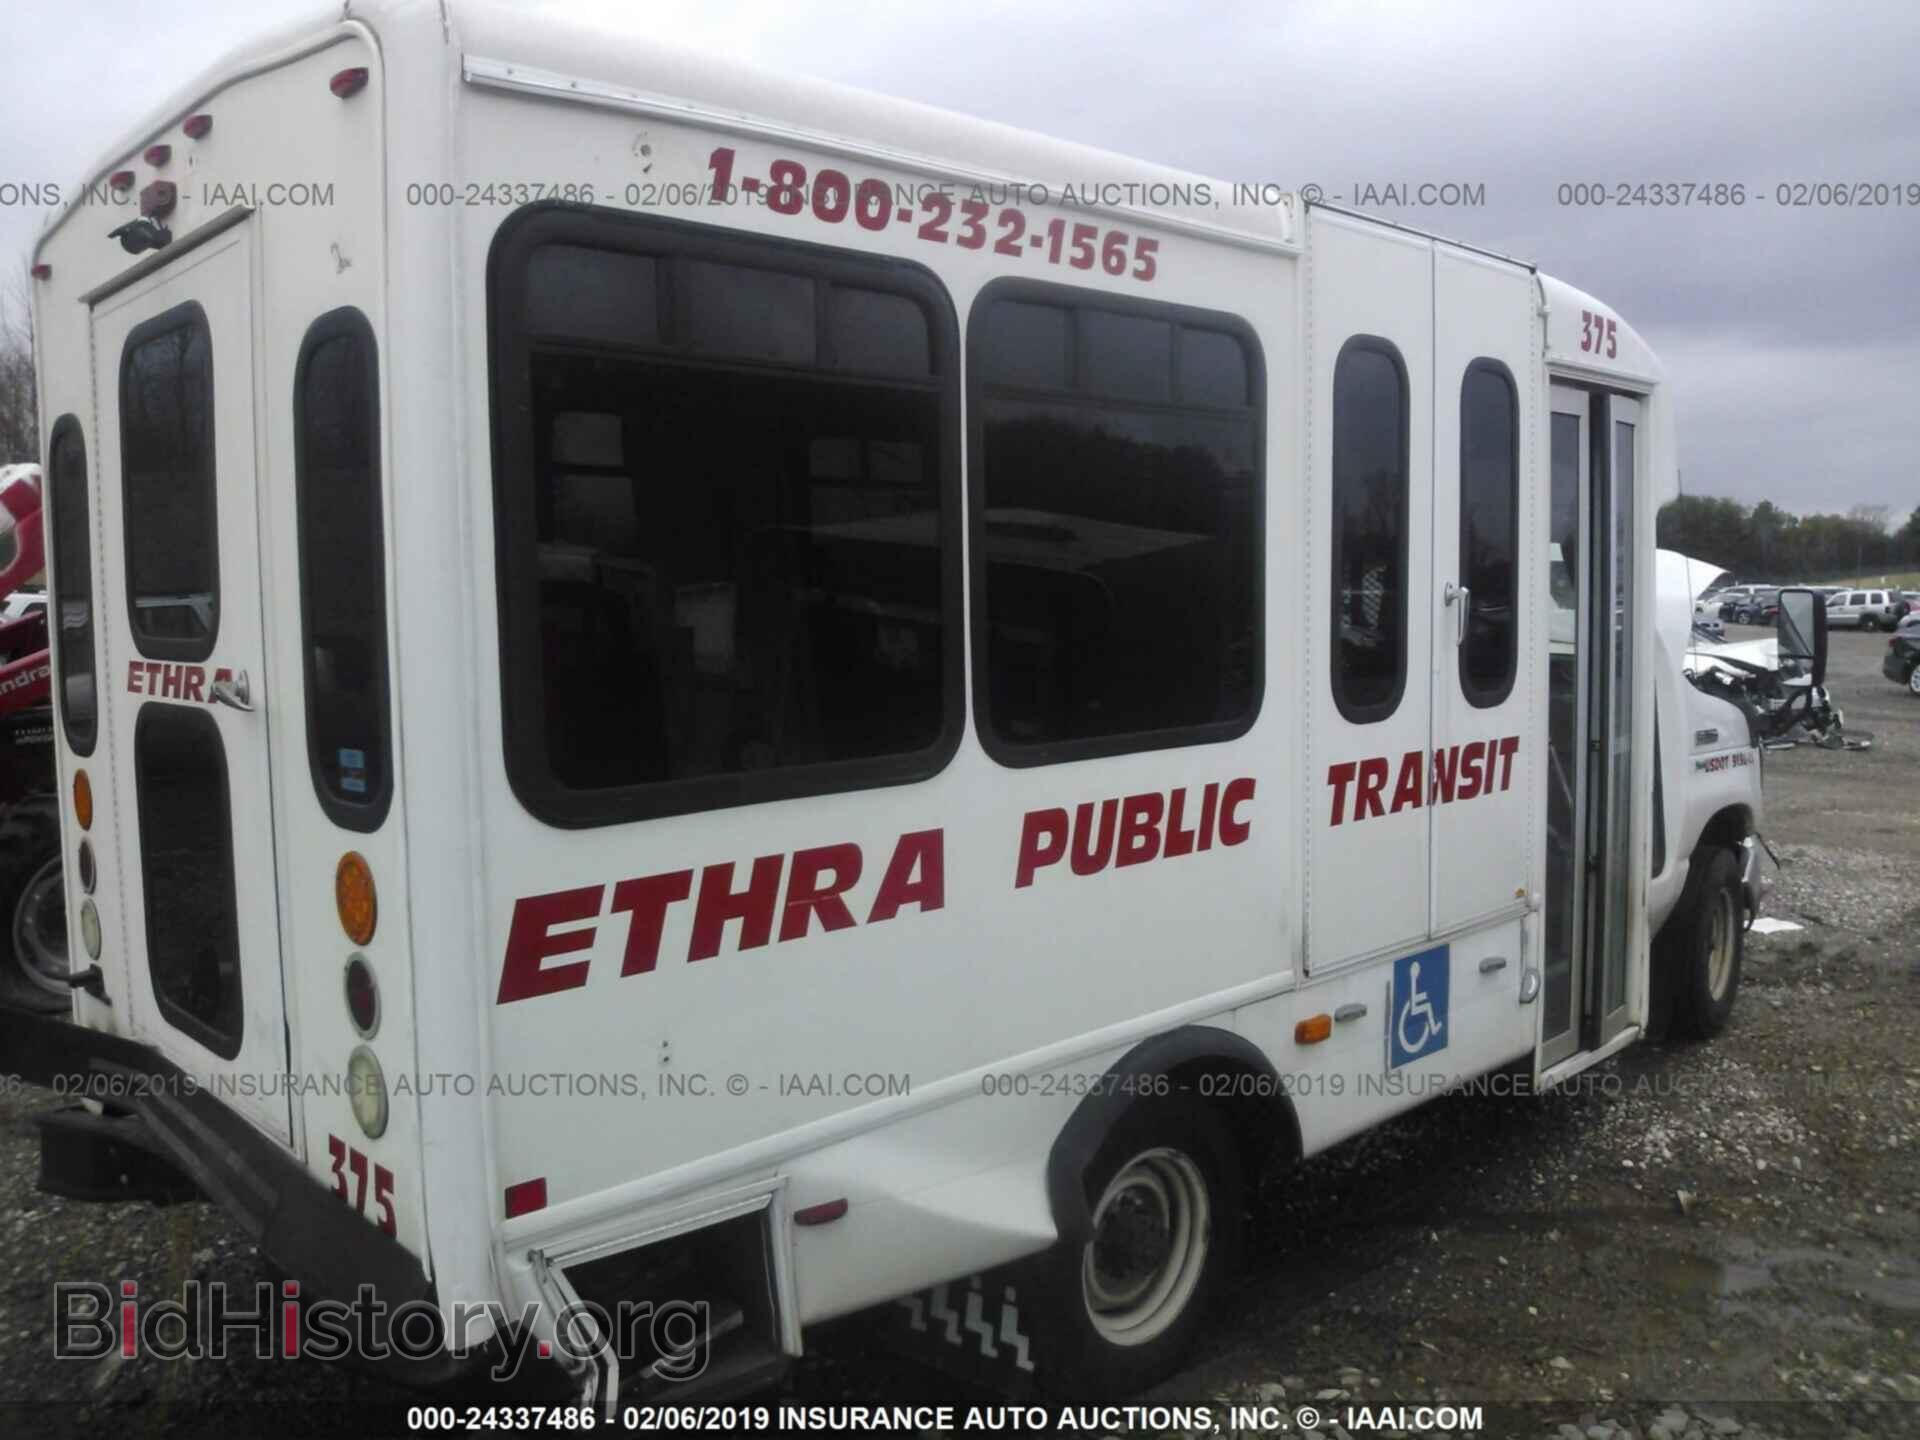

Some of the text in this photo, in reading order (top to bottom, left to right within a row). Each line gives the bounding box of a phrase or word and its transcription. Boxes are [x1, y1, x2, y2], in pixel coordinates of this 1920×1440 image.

[707, 147, 1160, 282] 1-800-232-1565
[1580, 309, 1617, 360] 375
[496, 735, 1520, 1005] ETHRA PUBLIC TRANSIT
[328, 1133, 398, 1240] 375
